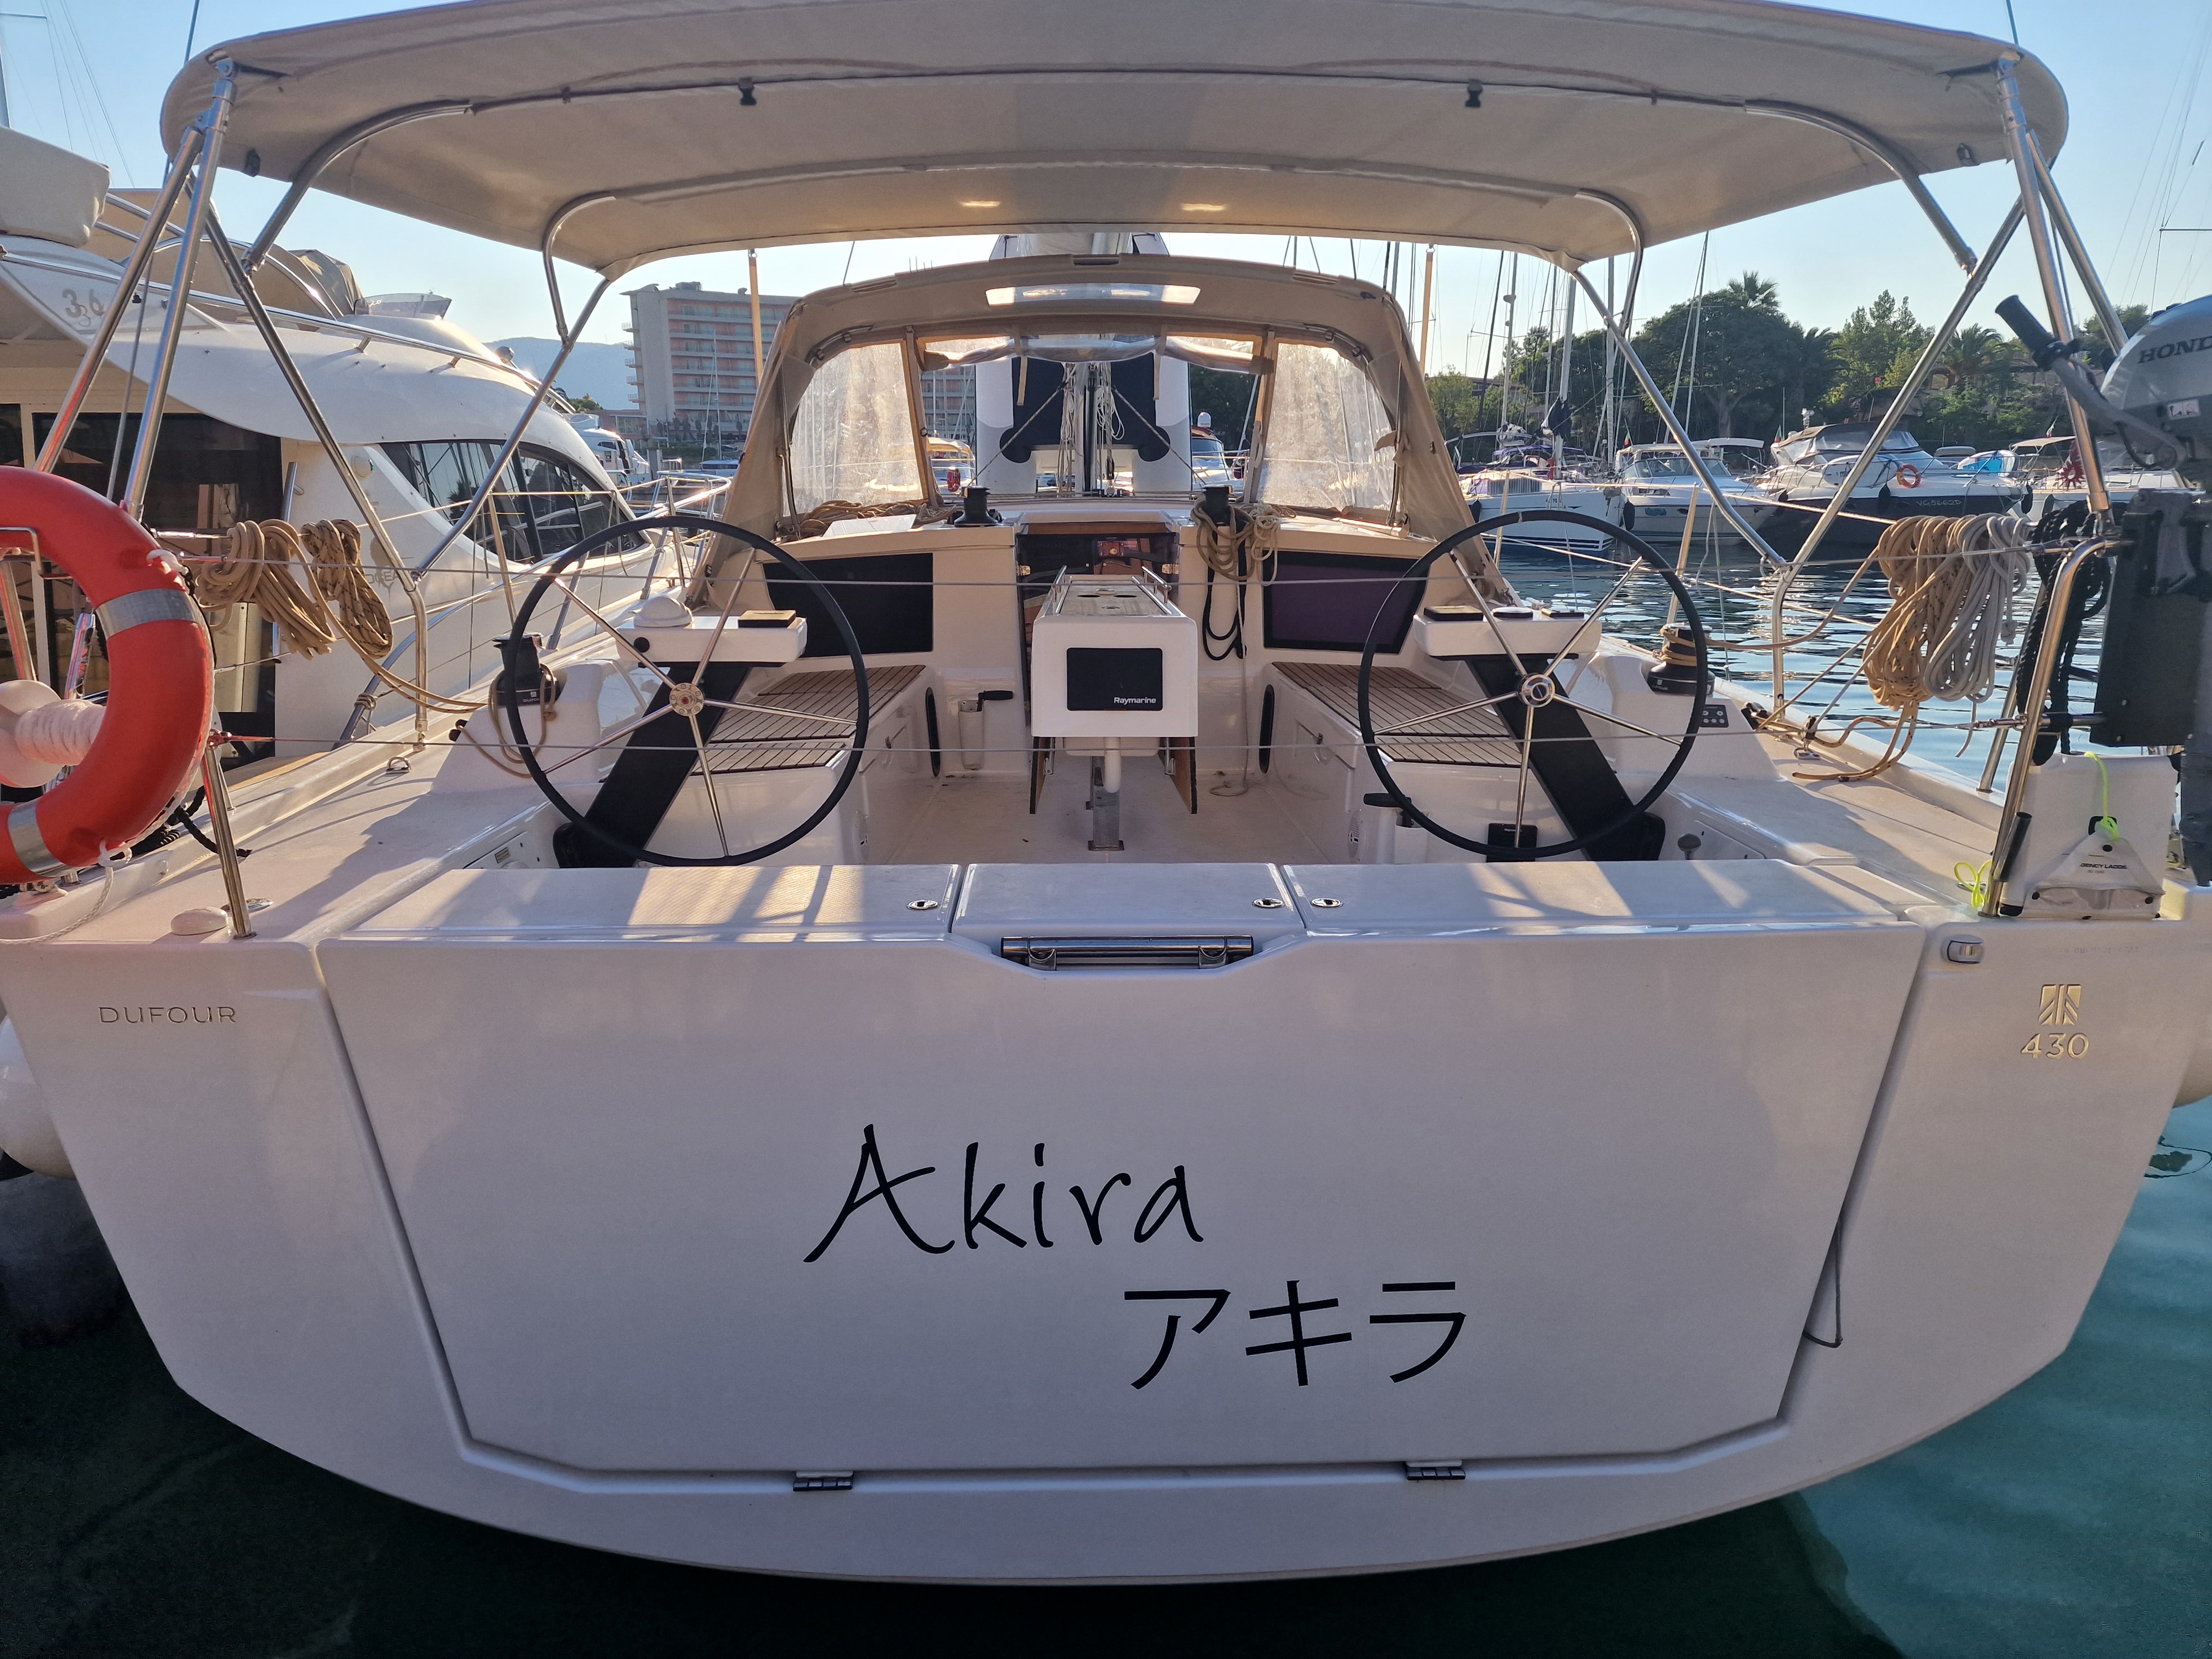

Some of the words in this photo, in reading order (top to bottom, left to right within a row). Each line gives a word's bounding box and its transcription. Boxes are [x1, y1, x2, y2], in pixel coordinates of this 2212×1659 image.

[1114, 697, 1156, 705] Raymarine
[98, 1006, 236, 1024] DUFOUR
[2020, 1032, 2090, 1060] 430
[802, 1123, 1204, 1264] Akira
[1123, 1279, 1467, 1391] アキラ
